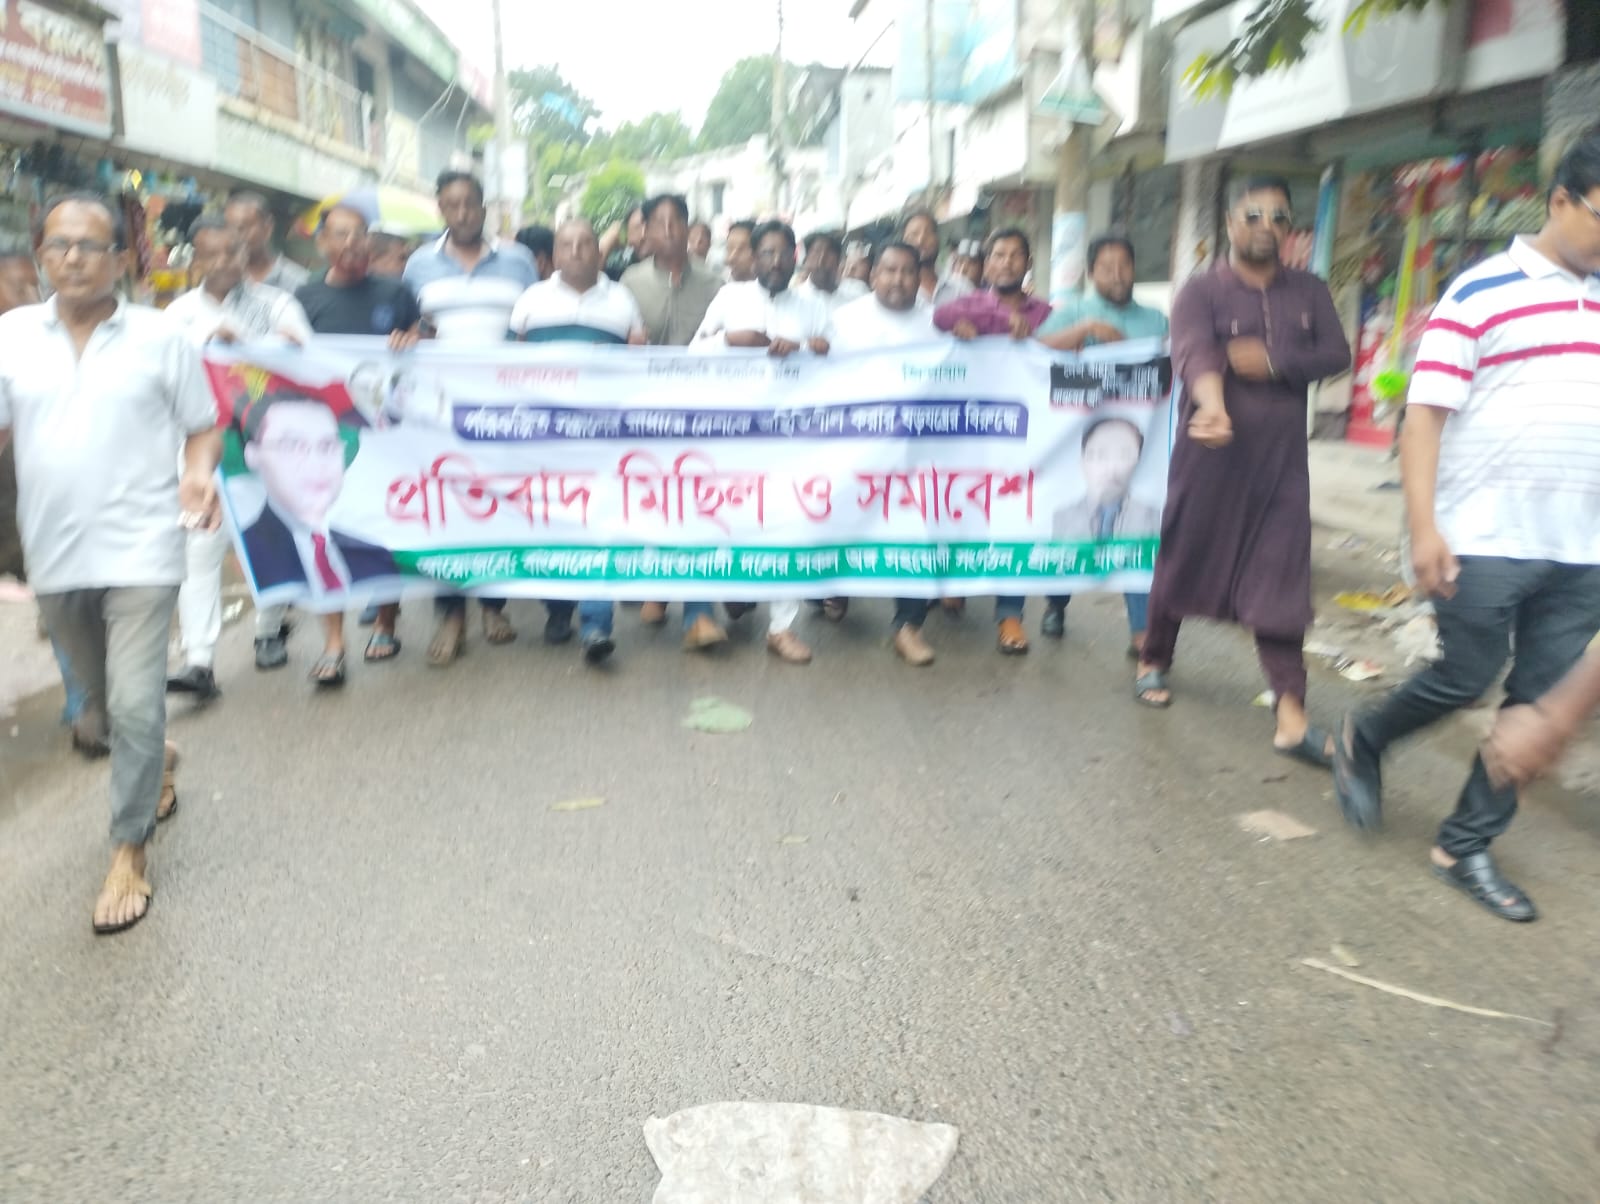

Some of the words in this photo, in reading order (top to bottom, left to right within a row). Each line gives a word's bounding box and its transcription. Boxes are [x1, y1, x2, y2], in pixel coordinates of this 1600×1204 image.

[849, 404, 897, 435] করার
[386, 452, 597, 534] প্রতিবাদ
[616, 450, 767, 535] মিছিল
[792, 473, 833, 523] ও
[855, 463, 1036, 525] সমাবেশ
[520, 548, 611, 578] বাংলাদেশ
[612, 546, 734, 577] জাতীয়তাবাদী
[739, 550, 790, 578] দলের
